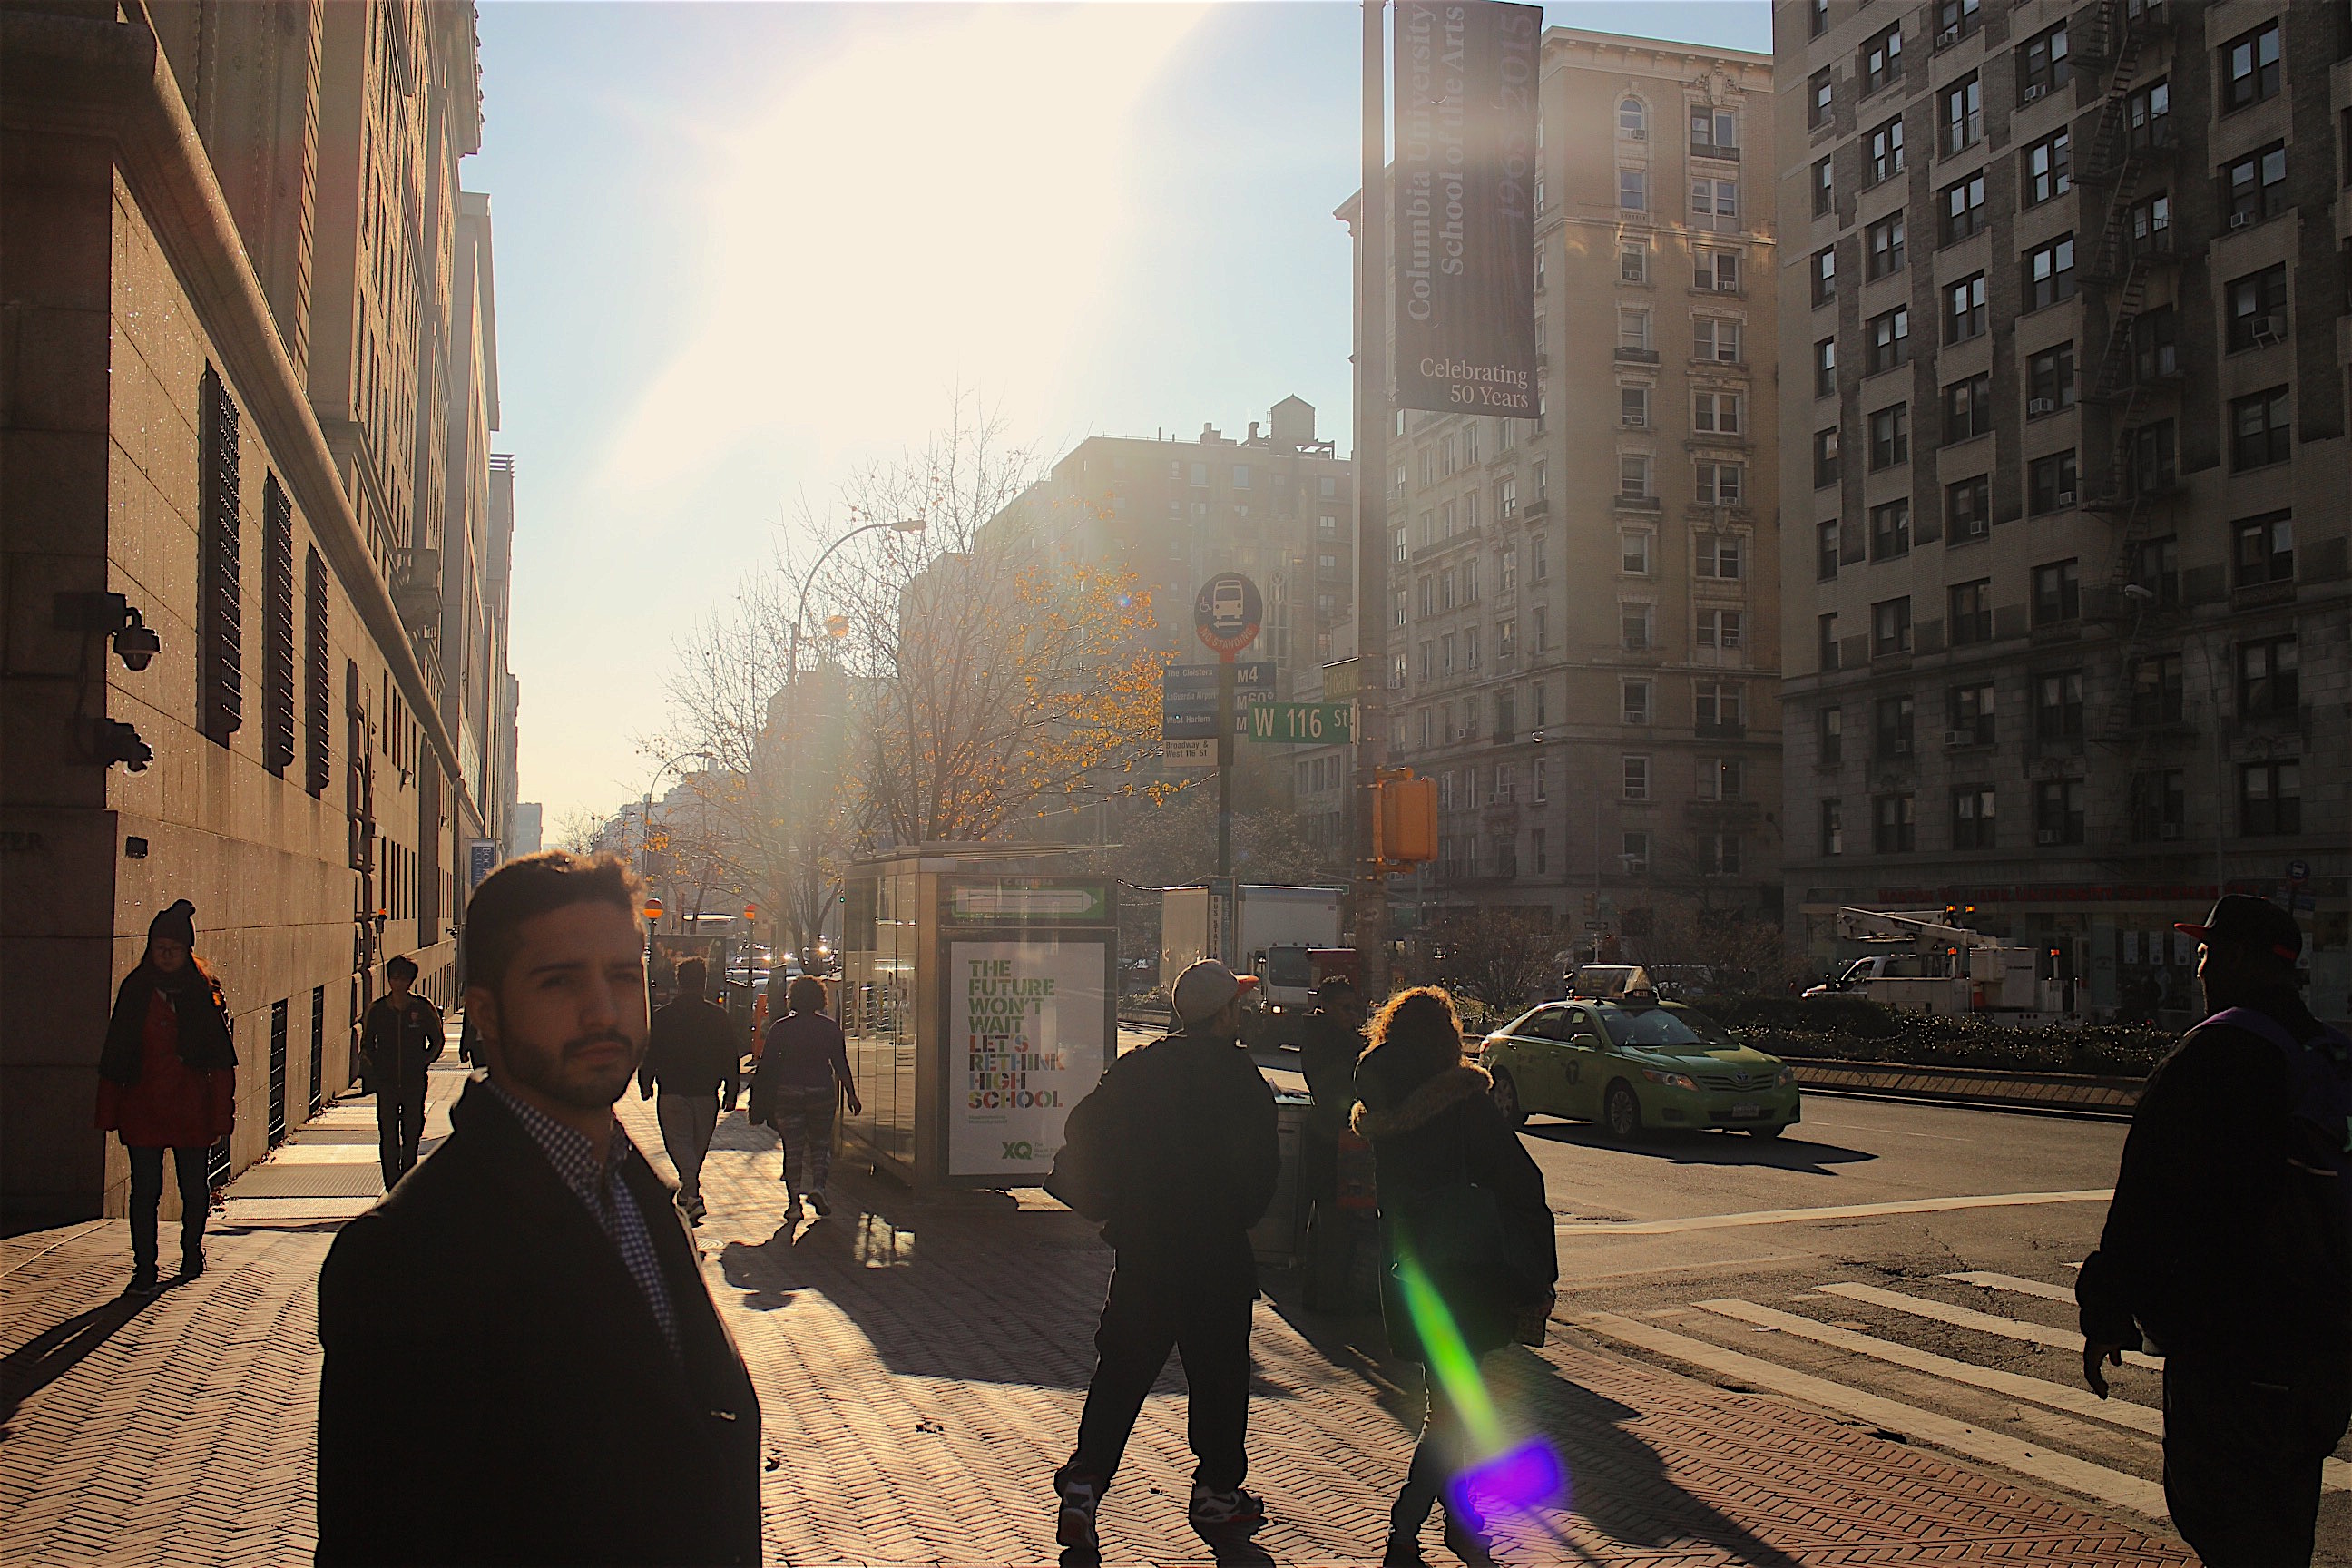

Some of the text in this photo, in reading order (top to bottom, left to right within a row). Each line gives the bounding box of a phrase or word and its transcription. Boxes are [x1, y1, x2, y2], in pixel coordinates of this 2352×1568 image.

[1438, 5, 1465, 275] School of the Arts
[1406, 3, 1436, 320] Columbia University
[1420, 358, 1528, 390] Celebrating
[1450, 384, 1529, 408] 50 Years
[1200, 630, 1254, 650] NO STANDING
[1182, 669, 1213, 677] Cloisters
[1237, 666, 1259, 683] M4
[1324, 666, 1359, 697] Broadw
[1166, 691, 1216, 701] LaGuardia Airport
[1166, 715, 1210, 724] West Harlem
[1254, 708, 1348, 738] W 116 St
[1165, 741, 1200, 750] Broadway
[1166, 750, 1183, 758] West
[1199, 749, 1207, 757] St
[968, 959, 1012, 978] THE
[968, 978, 1055, 996] FUTURE
[967, 997, 1044, 1015] WON'T
[968, 1016, 1025, 1034] WAIT
[969, 1034, 1029, 1053] LET'S
[969, 1054, 1065, 1072] RETHINK
[969, 1072, 1026, 1091] HIGH
[968, 1090, 1064, 1109] SCHOOL
[1002, 1141, 1032, 1161] XQ
